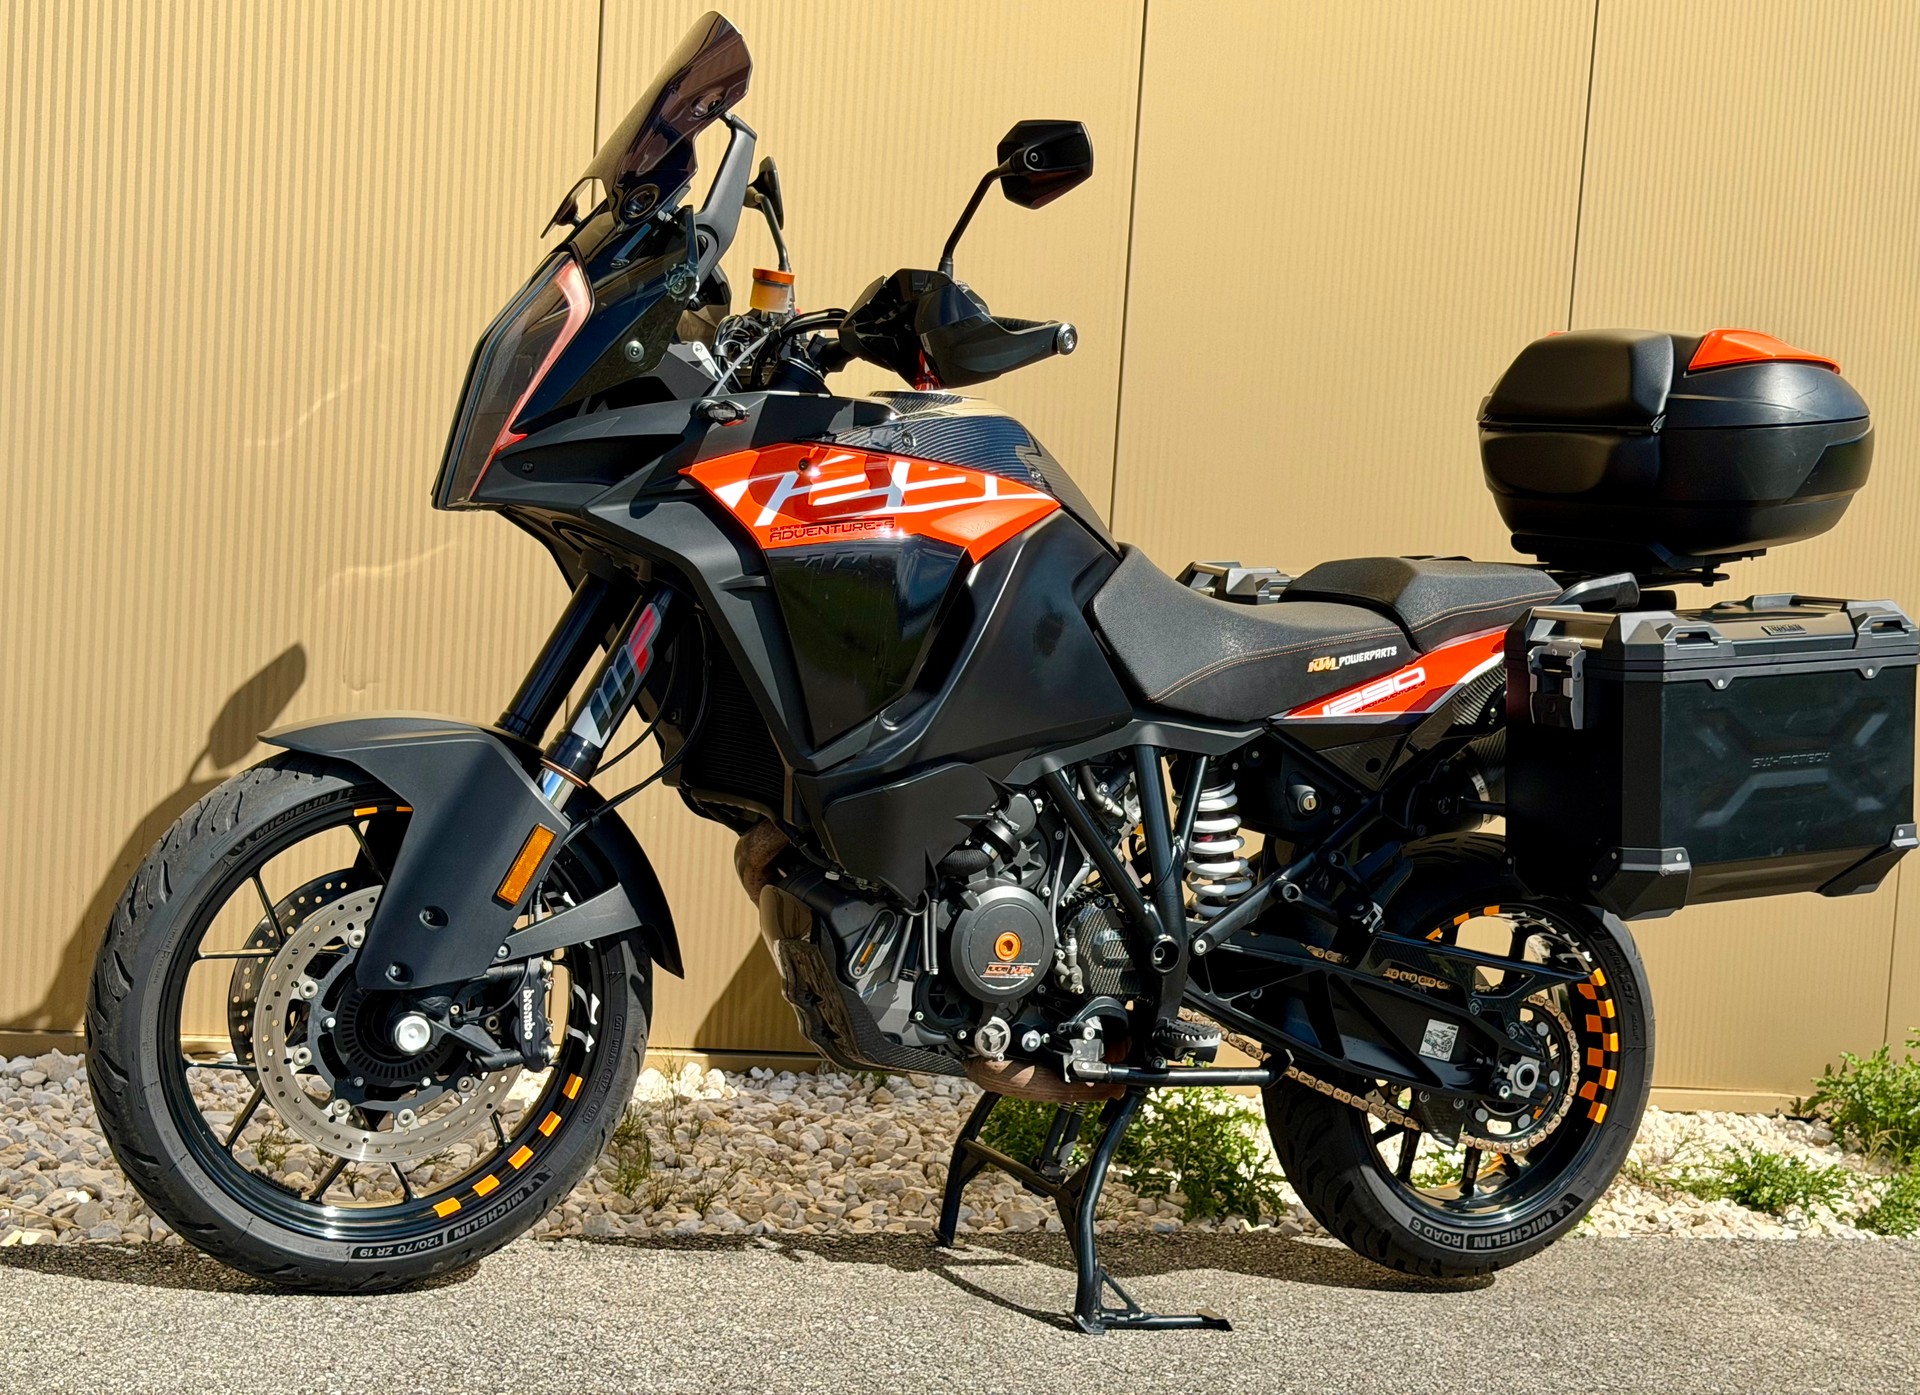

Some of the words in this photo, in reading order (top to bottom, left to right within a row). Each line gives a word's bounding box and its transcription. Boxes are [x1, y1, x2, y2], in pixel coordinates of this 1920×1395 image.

[769, 518, 895, 543] ADVENTURE-S
[1307, 656, 1339, 673] KTM
[1338, 646, 1398, 667] POWERPARTS
[1322, 667, 1426, 717] 1290
[254, 793, 333, 842] MICHELIN
[523, 989, 536, 1040] brembo
[454, 1190, 525, 1240] MICHELIN
[1411, 1219, 1421, 1230] 6
[1423, 1224, 1462, 1247] ROAD
[1473, 1213, 1554, 1248] MICHELIN
[359, 1248, 374, 1258] 19
[376, 1246, 393, 1257] ZR
[397, 1236, 441, 1254] 120/70
